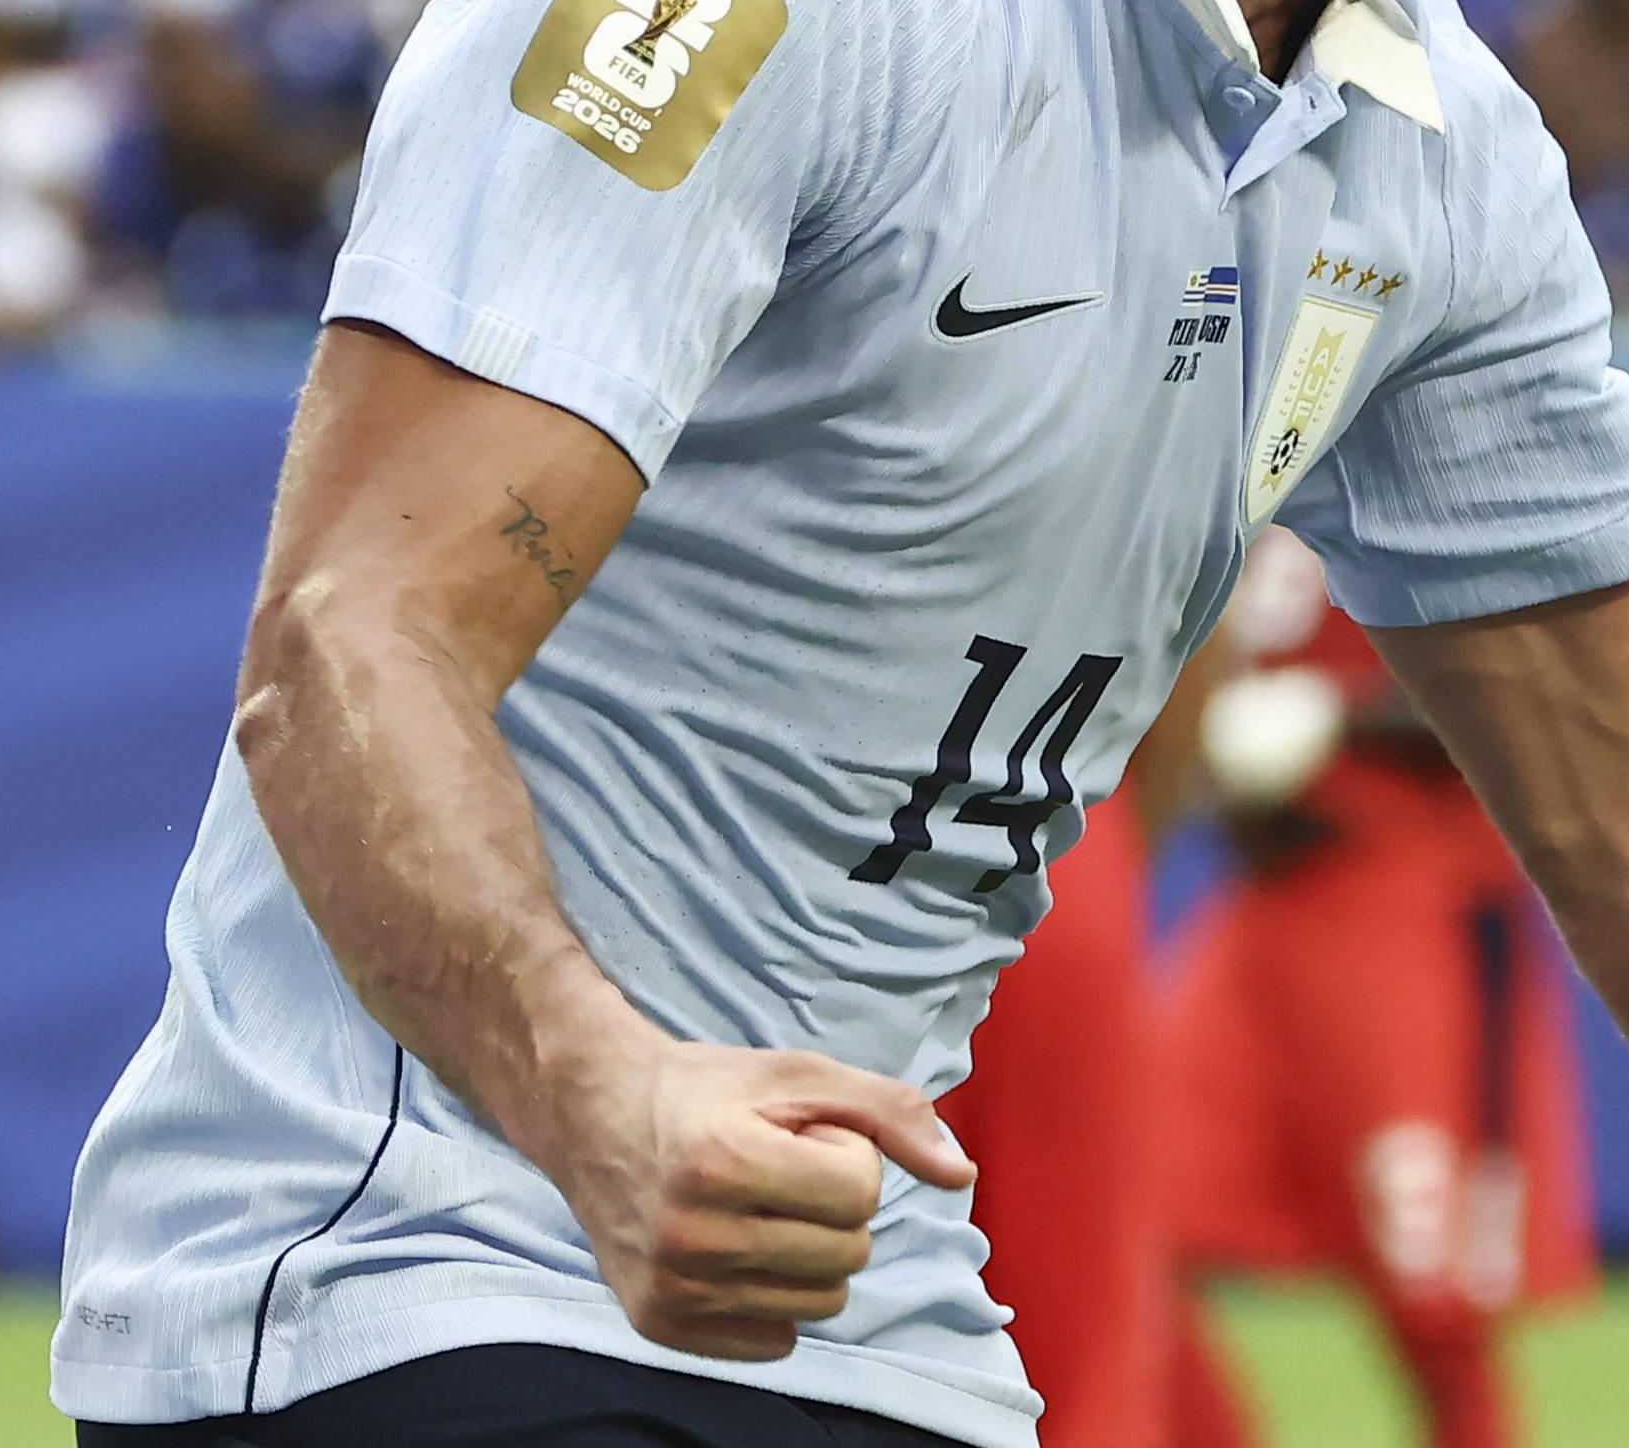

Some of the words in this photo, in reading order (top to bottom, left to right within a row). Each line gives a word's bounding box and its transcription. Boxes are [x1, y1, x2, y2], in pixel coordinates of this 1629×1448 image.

[566, 71, 623, 114] WORLD
[620, 105, 652, 134] CUP
[607, 55, 648, 90] FIFA
[551, 87, 644, 155] 2026
[848, 634, 1124, 893] 14
